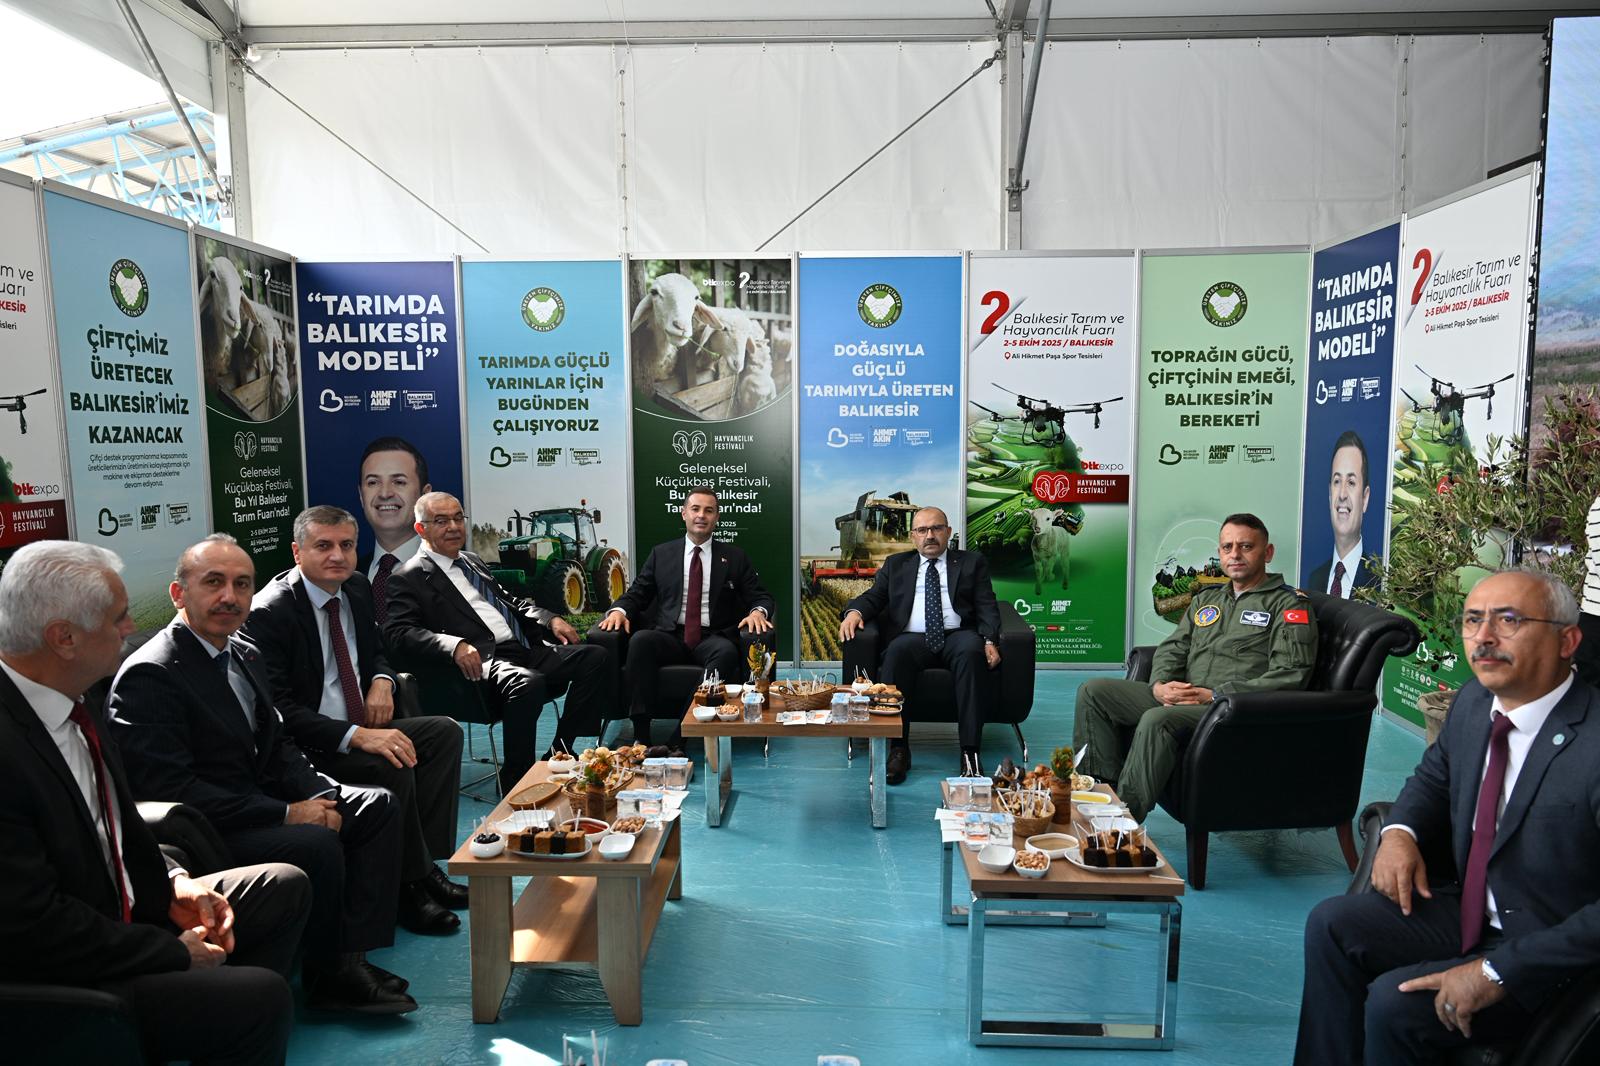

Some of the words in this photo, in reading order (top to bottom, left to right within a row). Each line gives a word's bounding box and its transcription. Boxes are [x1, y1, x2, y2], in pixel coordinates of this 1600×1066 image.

[18, 268, 34, 281] ve
[1410, 248, 1432, 305] 2
[1433, 264, 1474, 287] Balıkesir
[1475, 259, 1504, 276] Tarım
[1508, 254, 1521, 268] ve
[702, 278, 736, 287] btkexpo
[739, 271, 750, 289] 2
[1425, 278, 1482, 304] Hayvancılık
[1484, 273, 1511, 290] Fuarı
[1315, 289, 1393, 333] BALIKESİR
[1425, 307, 1435, 317] 2-5
[1435, 302, 1451, 315] EKİM
[1451, 301, 1467, 312] 2025
[1472, 290, 1510, 307] BALIKESİR
[981, 291, 1010, 335] 2
[1013, 313, 1068, 324] Balıkesir
[1071, 313, 1106, 324] Tarım
[1110, 315, 1125, 324] ve
[1436, 322, 1453, 331] Hikmet
[1454, 320, 1466, 329] Paşa
[1466, 317, 1478, 326] Spor
[1478, 312, 1499, 322] Tesisleri
[307, 317, 448, 344] BALIKESİR
[1003, 324, 1079, 338] Hayvancılık
[1082, 324, 1115, 335] Fuarı
[87, 324, 169, 358] ÇİFTÇİMİZ
[834, 340, 925, 356] DOĞASIYLA
[1018, 338, 1040, 346] EKİM
[1041, 339, 1062, 347] 2025
[1069, 337, 1114, 346] BALIKESİR
[478, 356, 551, 369] TARIMDA
[554, 352, 610, 372] GÜÇLÜ
[1151, 346, 1237, 363] TOPRAĞIN
[1241, 346, 1294, 364] GÜCÜ,
[91, 355, 173, 385] ÜRETECEK
[852, 361, 906, 380] GÜÇLÜ
[486, 377, 566, 390] YARINLAR
[570, 373, 604, 393] İÇİN
[1148, 368, 1232, 389] ÇİFTÇİNİN
[1236, 367, 1295, 386] EMEĞİ,
[370, 390, 397, 399] AHMET
[804, 384, 888, 397] TARIMIYLA
[892, 381, 954, 397] ÜRETEN
[370, 398, 390, 406] AKIN
[498, 395, 589, 411] BUGÜNDEN
[839, 401, 919, 417] BALIKESİR
[1180, 410, 1260, 427] BEREKETİ
[493, 419, 599, 435] ÇALIŞIYORUZ
[89, 426, 183, 444] KAZANACAK
[873, 435, 891, 443] AKIN
[1208, 445, 1236, 453] AHMET
[1208, 452, 1228, 460] AKIN
[240, 466, 281, 478] Geleneksel
[679, 463, 747, 474] Geleneksel
[1080, 461, 1124, 472] btkexpo
[130, 472, 152, 480] ekipman
[655, 477, 715, 488] Küçükbaş
[718, 476, 771, 488] Festivali,
[1077, 479, 1116, 487] HAYVANCILIK
[13, 482, 59, 497] btkexpo
[224, 481, 265, 495] Küçükbaş
[265, 479, 293, 491] Festivali,
[1077, 486, 1107, 494] FESTİVALİ
[235, 497, 246, 508] Bu
[247, 495, 258, 507] Yıl
[259, 492, 288, 506] Balıkesir
[669, 490, 685, 500] Bu
[12, 508, 55, 521] HAYVANCILIK
[140, 505, 161, 516] AHMET
[233, 512, 256, 523] Tarım
[13, 519, 47, 533] FESTİVALİ
[141, 514, 157, 524] AKIN
[723, 530, 738, 538] Paşa
